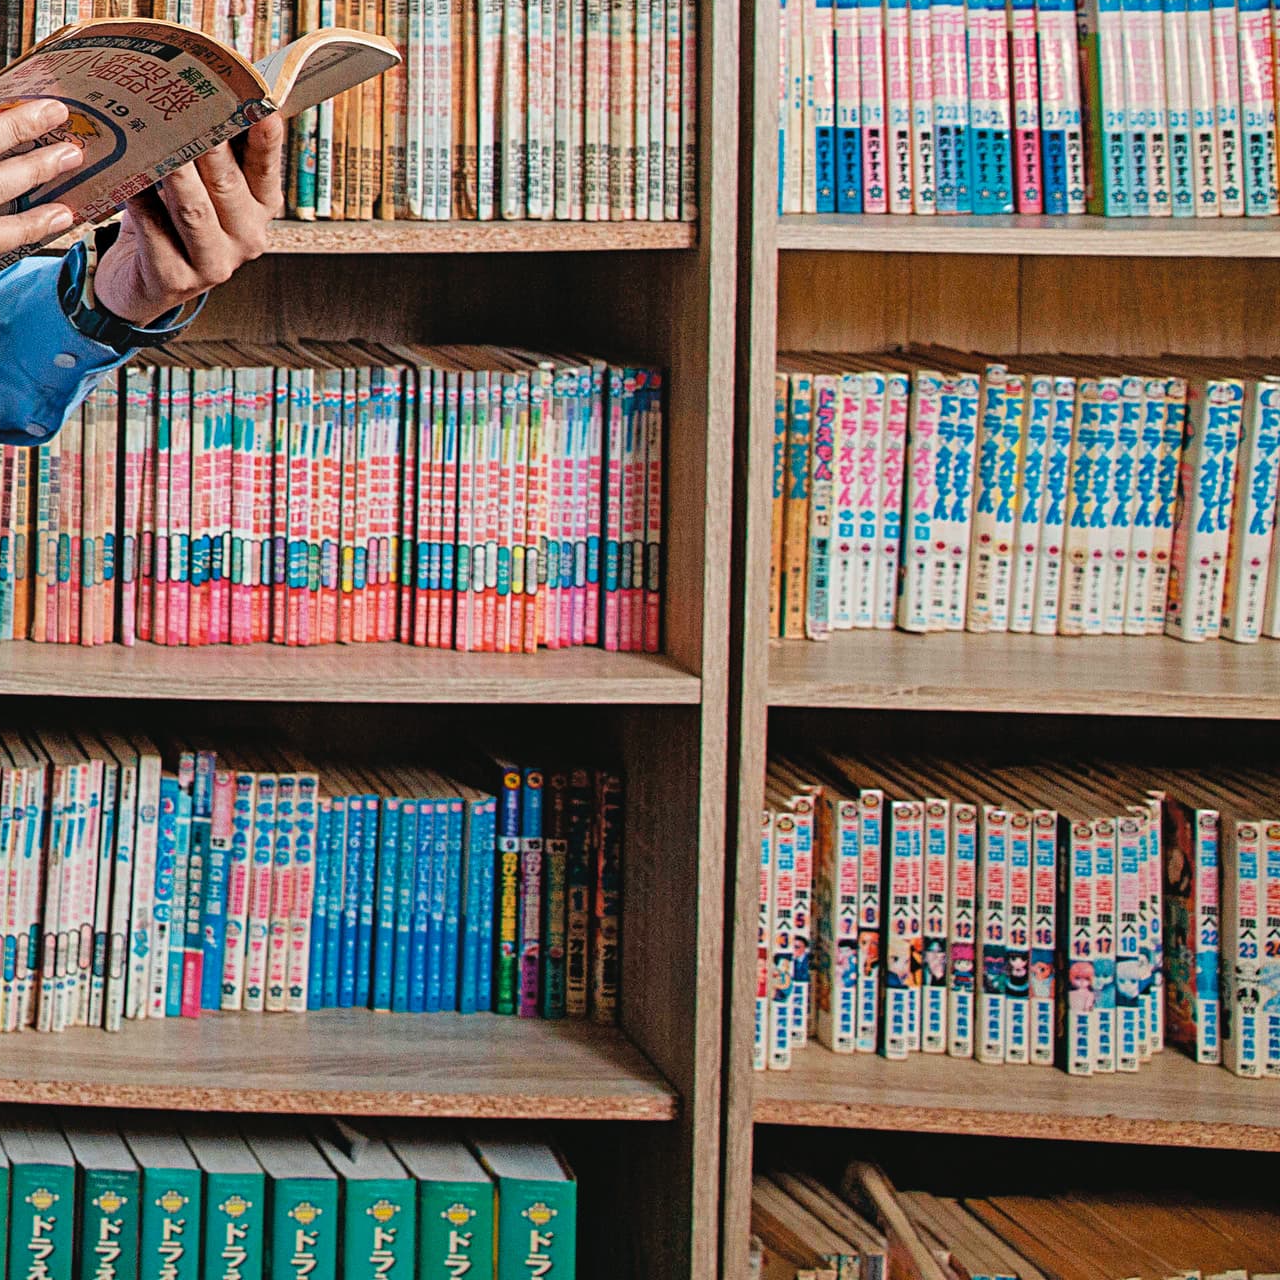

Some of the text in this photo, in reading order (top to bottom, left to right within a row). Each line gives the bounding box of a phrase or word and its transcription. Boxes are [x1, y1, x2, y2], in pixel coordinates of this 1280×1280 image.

[842, 109, 857, 121] 18
[838, 398, 858, 507] ドラえもん
[859, 399, 881, 507] ドラえもん
[884, 400, 906, 508] ドラえもん
[913, 399, 936, 508] ドラえもん
[795, 913, 805, 929] 5
[865, 907, 875, 923] 8
[844, 918, 853, 935] 7
[897, 919, 906, 935] 9
[929, 917, 943, 933] 11
[955, 921, 972, 939] 12
[986, 924, 1003, 941] 13
[780, 933, 789, 948] 3
[1010, 927, 1027, 945] 15
[1035, 927, 1052, 944] 16
[1121, 936, 1137, 952] 18
[1201, 930, 1219, 946] 22
[1074, 939, 1090, 956] 14
[1096, 937, 1112, 954] 17
[1239, 942, 1258, 959] 23
[291, 1229, 320, 1280] ドラ
[369, 1227, 397, 1280] ドラ
[445, 1230, 473, 1280] ドラ
[525, 1230, 554, 1280] ドラ
